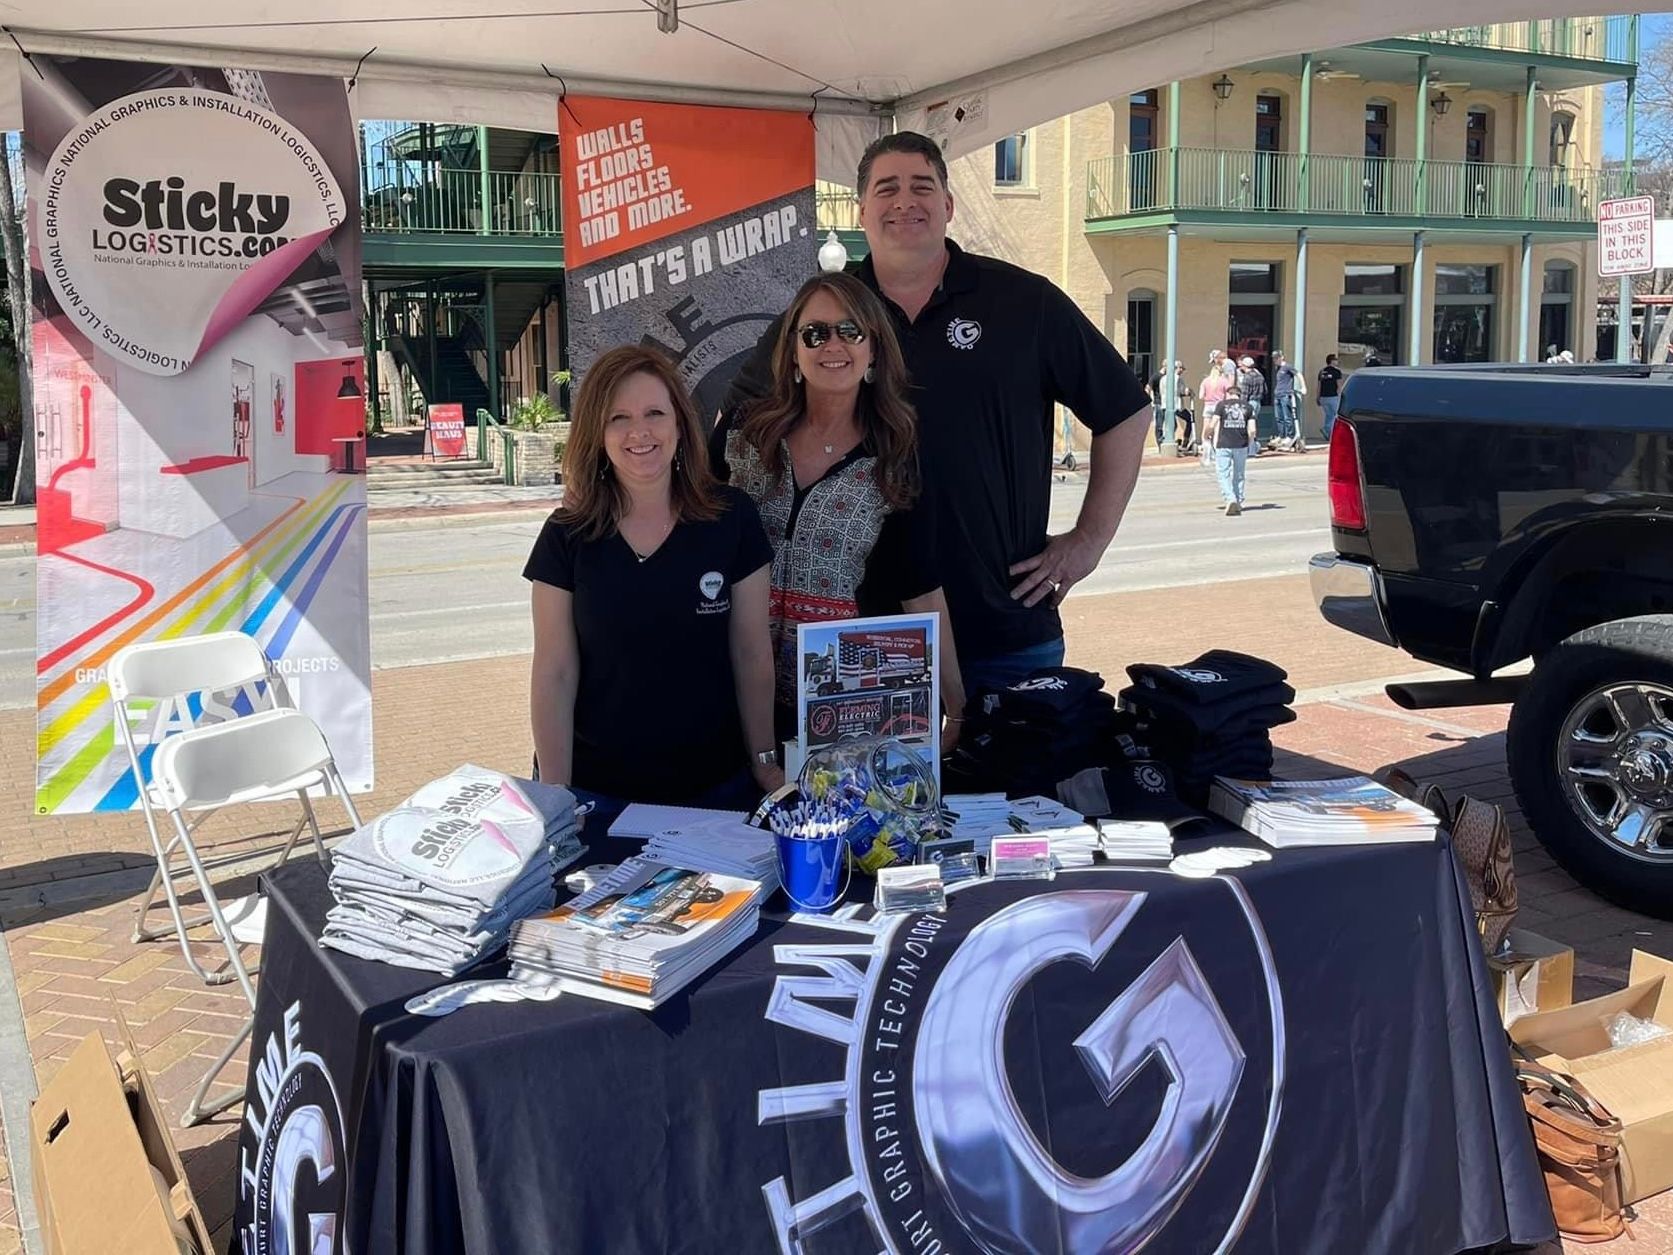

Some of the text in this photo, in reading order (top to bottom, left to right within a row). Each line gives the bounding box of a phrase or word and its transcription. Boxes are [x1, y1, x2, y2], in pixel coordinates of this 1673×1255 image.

[110, 96, 176, 121] GRAPHICS
[179, 95, 189, 106] &
[193, 96, 281, 135] INSTALLATION
[60, 117, 111, 167] NATIONAL
[576, 118, 644, 161] WALLS
[280, 131, 332, 201] LOGICSTICS,
[576, 144, 653, 191] FLOORS
[47, 167, 66, 237] GRAPHICS
[103, 176, 290, 235] Sticky
[578, 166, 672, 219] VEHICLES
[1601, 201, 1648, 219] NO PARKING
[579, 189, 693, 248] AND MORE.
[1603, 219, 1649, 235] THIS SIDE
[1605, 233, 1646, 247] IN THIS
[49, 241, 82, 307] NATIONAL
[94, 253, 134, 265] National
[136, 256, 176, 269] Graphics
[178, 260, 185, 268] &
[187, 260, 237, 270] Installation
[584, 204, 808, 315] THAT'S A WRAP.
[1608, 247, 1644, 261] BLOCK
[79, 306, 101, 329] LLC
[102, 325, 178, 370] LOGICSTICS,
[876, 914, 948, 1051] TECHNOLOGY
[260, 1138, 274, 1209] GRAPHIC
[272, 1072, 302, 1136] TECHNOLOGY
[873, 1069, 912, 1204] GRAPHIC
